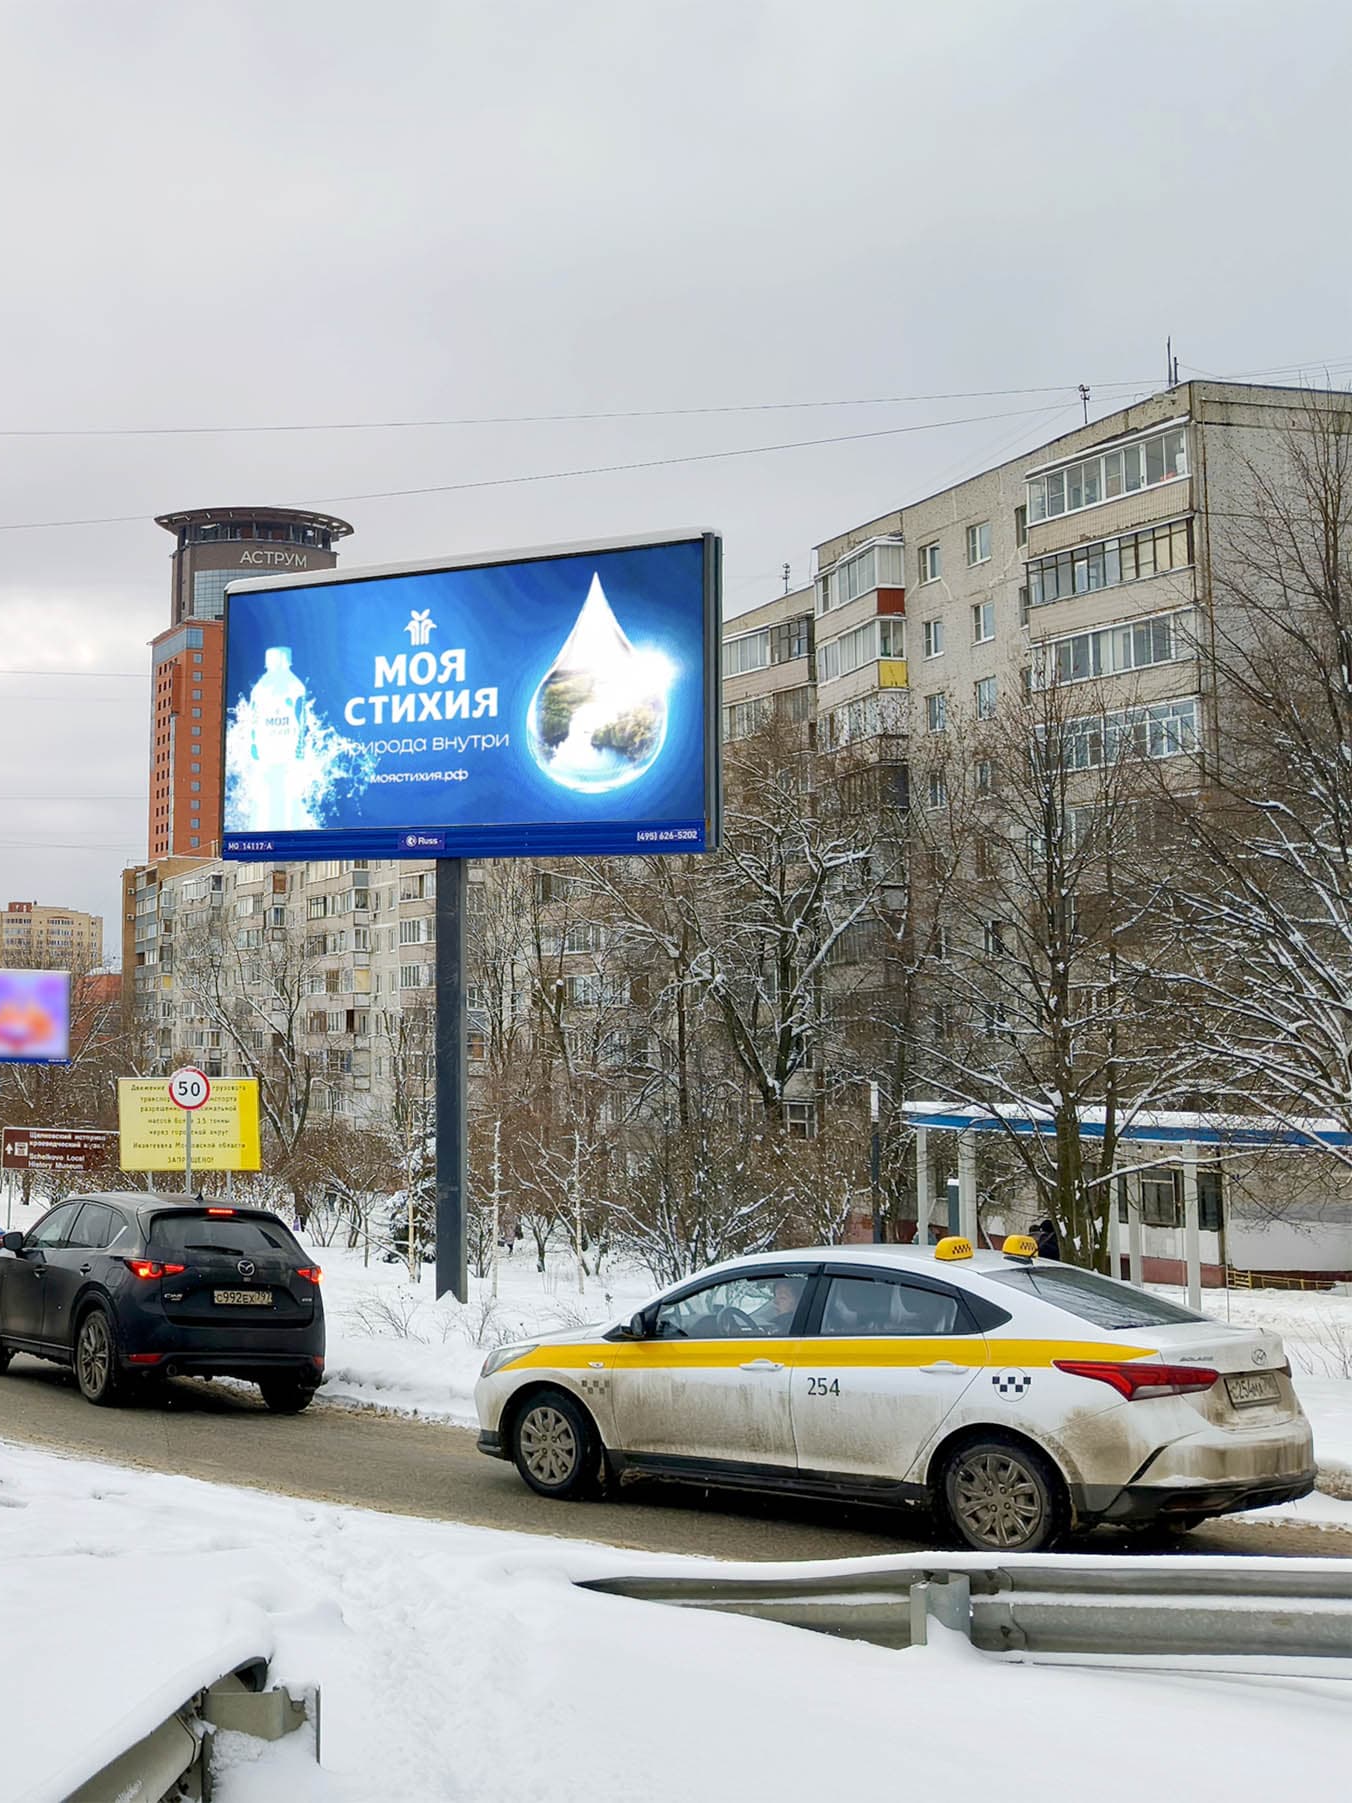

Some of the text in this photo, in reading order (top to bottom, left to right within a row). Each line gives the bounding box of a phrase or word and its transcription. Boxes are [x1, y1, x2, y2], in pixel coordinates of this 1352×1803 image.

[240, 551, 307, 568] АСТРУМ
[374, 649, 466, 688] МОЯ
[344, 687, 498, 727] СТИХИЯ
[343, 733, 510, 757] рирода внутри
[370, 768, 469, 784] моястихия.рф
[417, 836, 438, 846] Russ
[636, 830, 698, 842] (495) 626-5202
[178, 1081, 201, 1097] 50
[807, 1377, 840, 1396] 254
